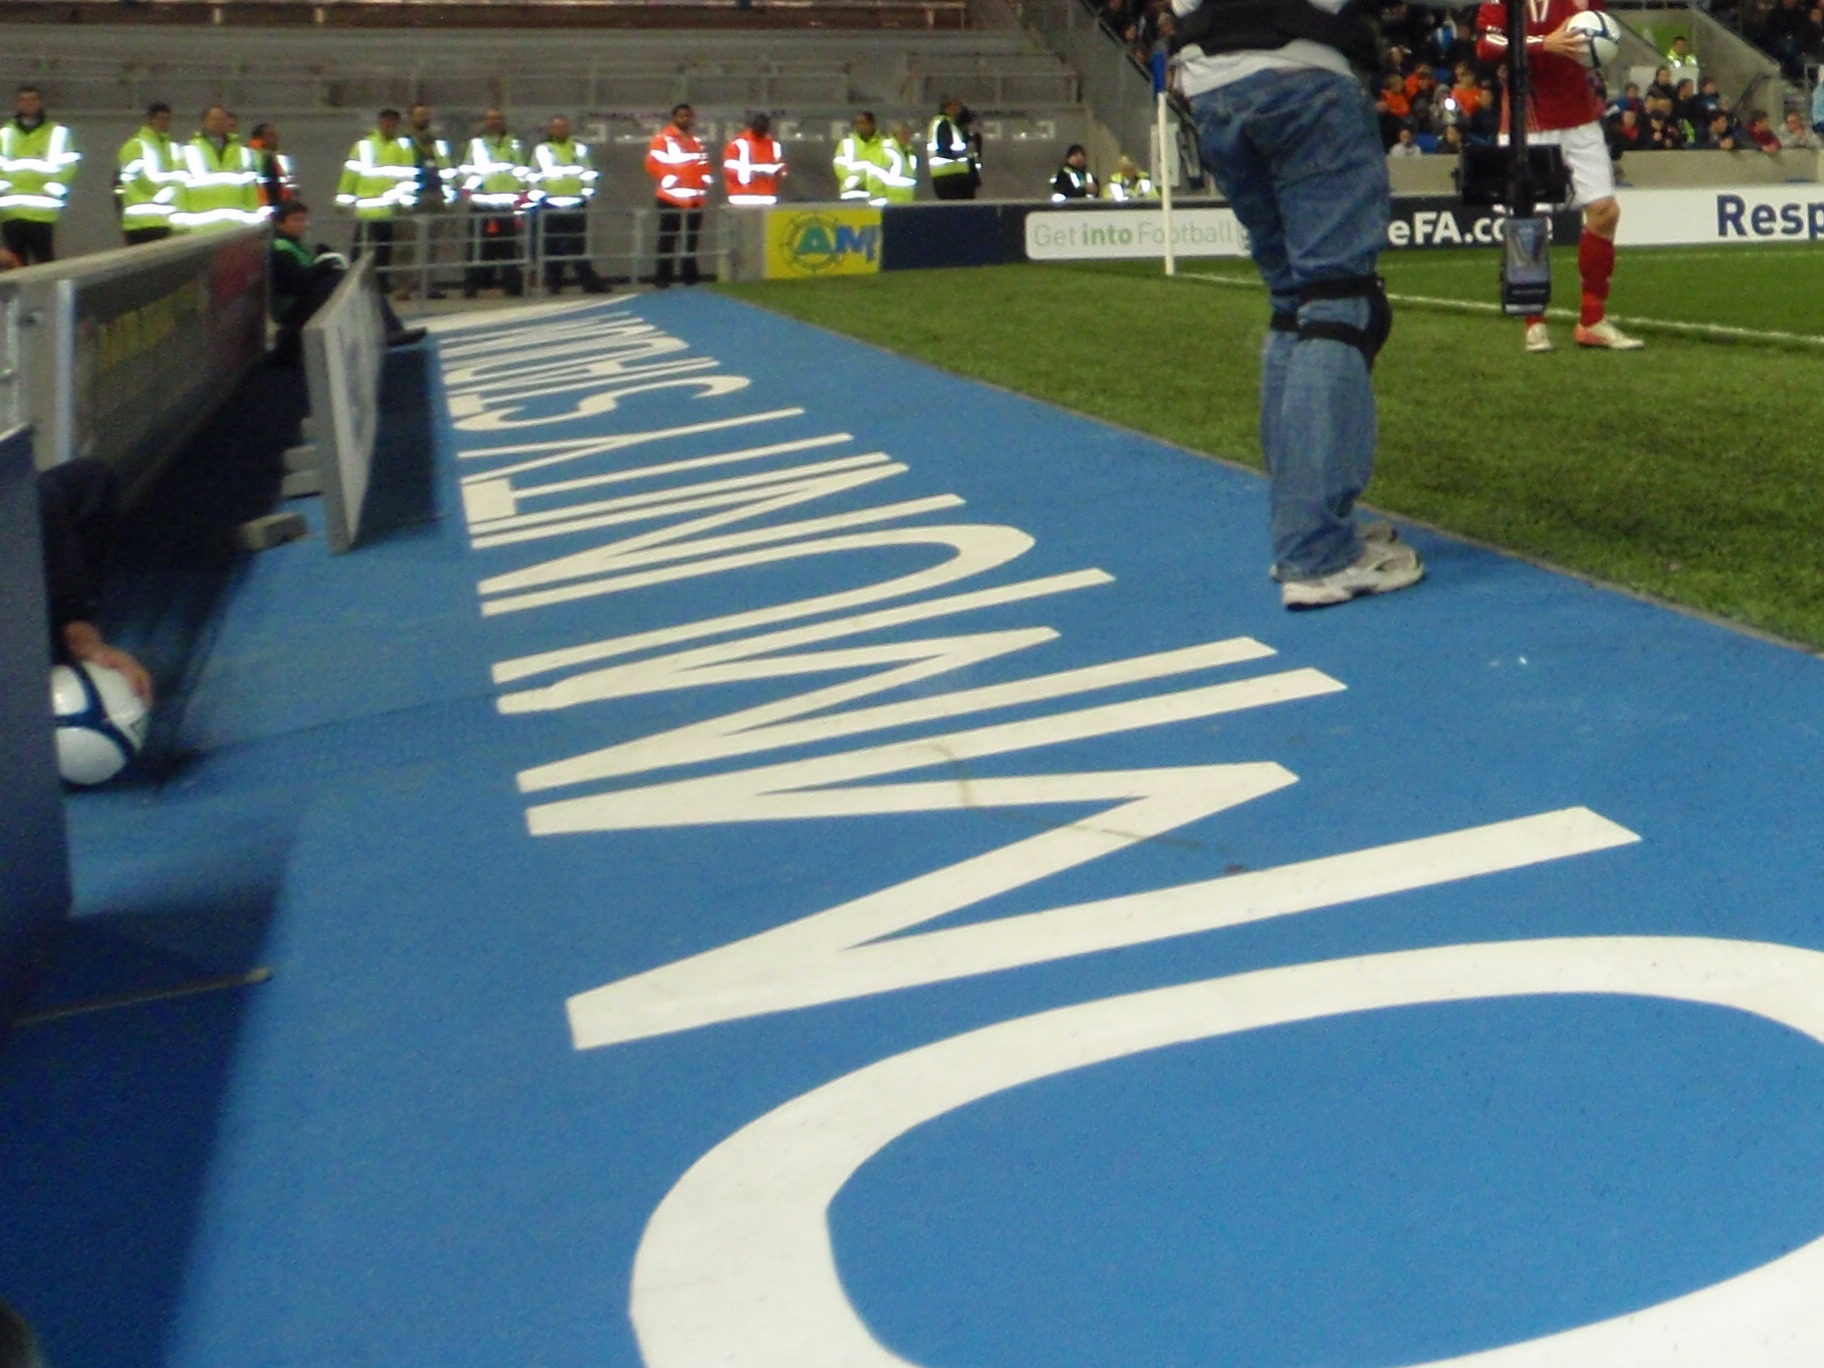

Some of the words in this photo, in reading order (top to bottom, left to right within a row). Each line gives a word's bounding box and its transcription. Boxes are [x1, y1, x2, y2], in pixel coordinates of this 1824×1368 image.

[1033, 223, 1077, 246] Get
[1081, 222, 1133, 246] into
[1137, 220, 1233, 246] Football
